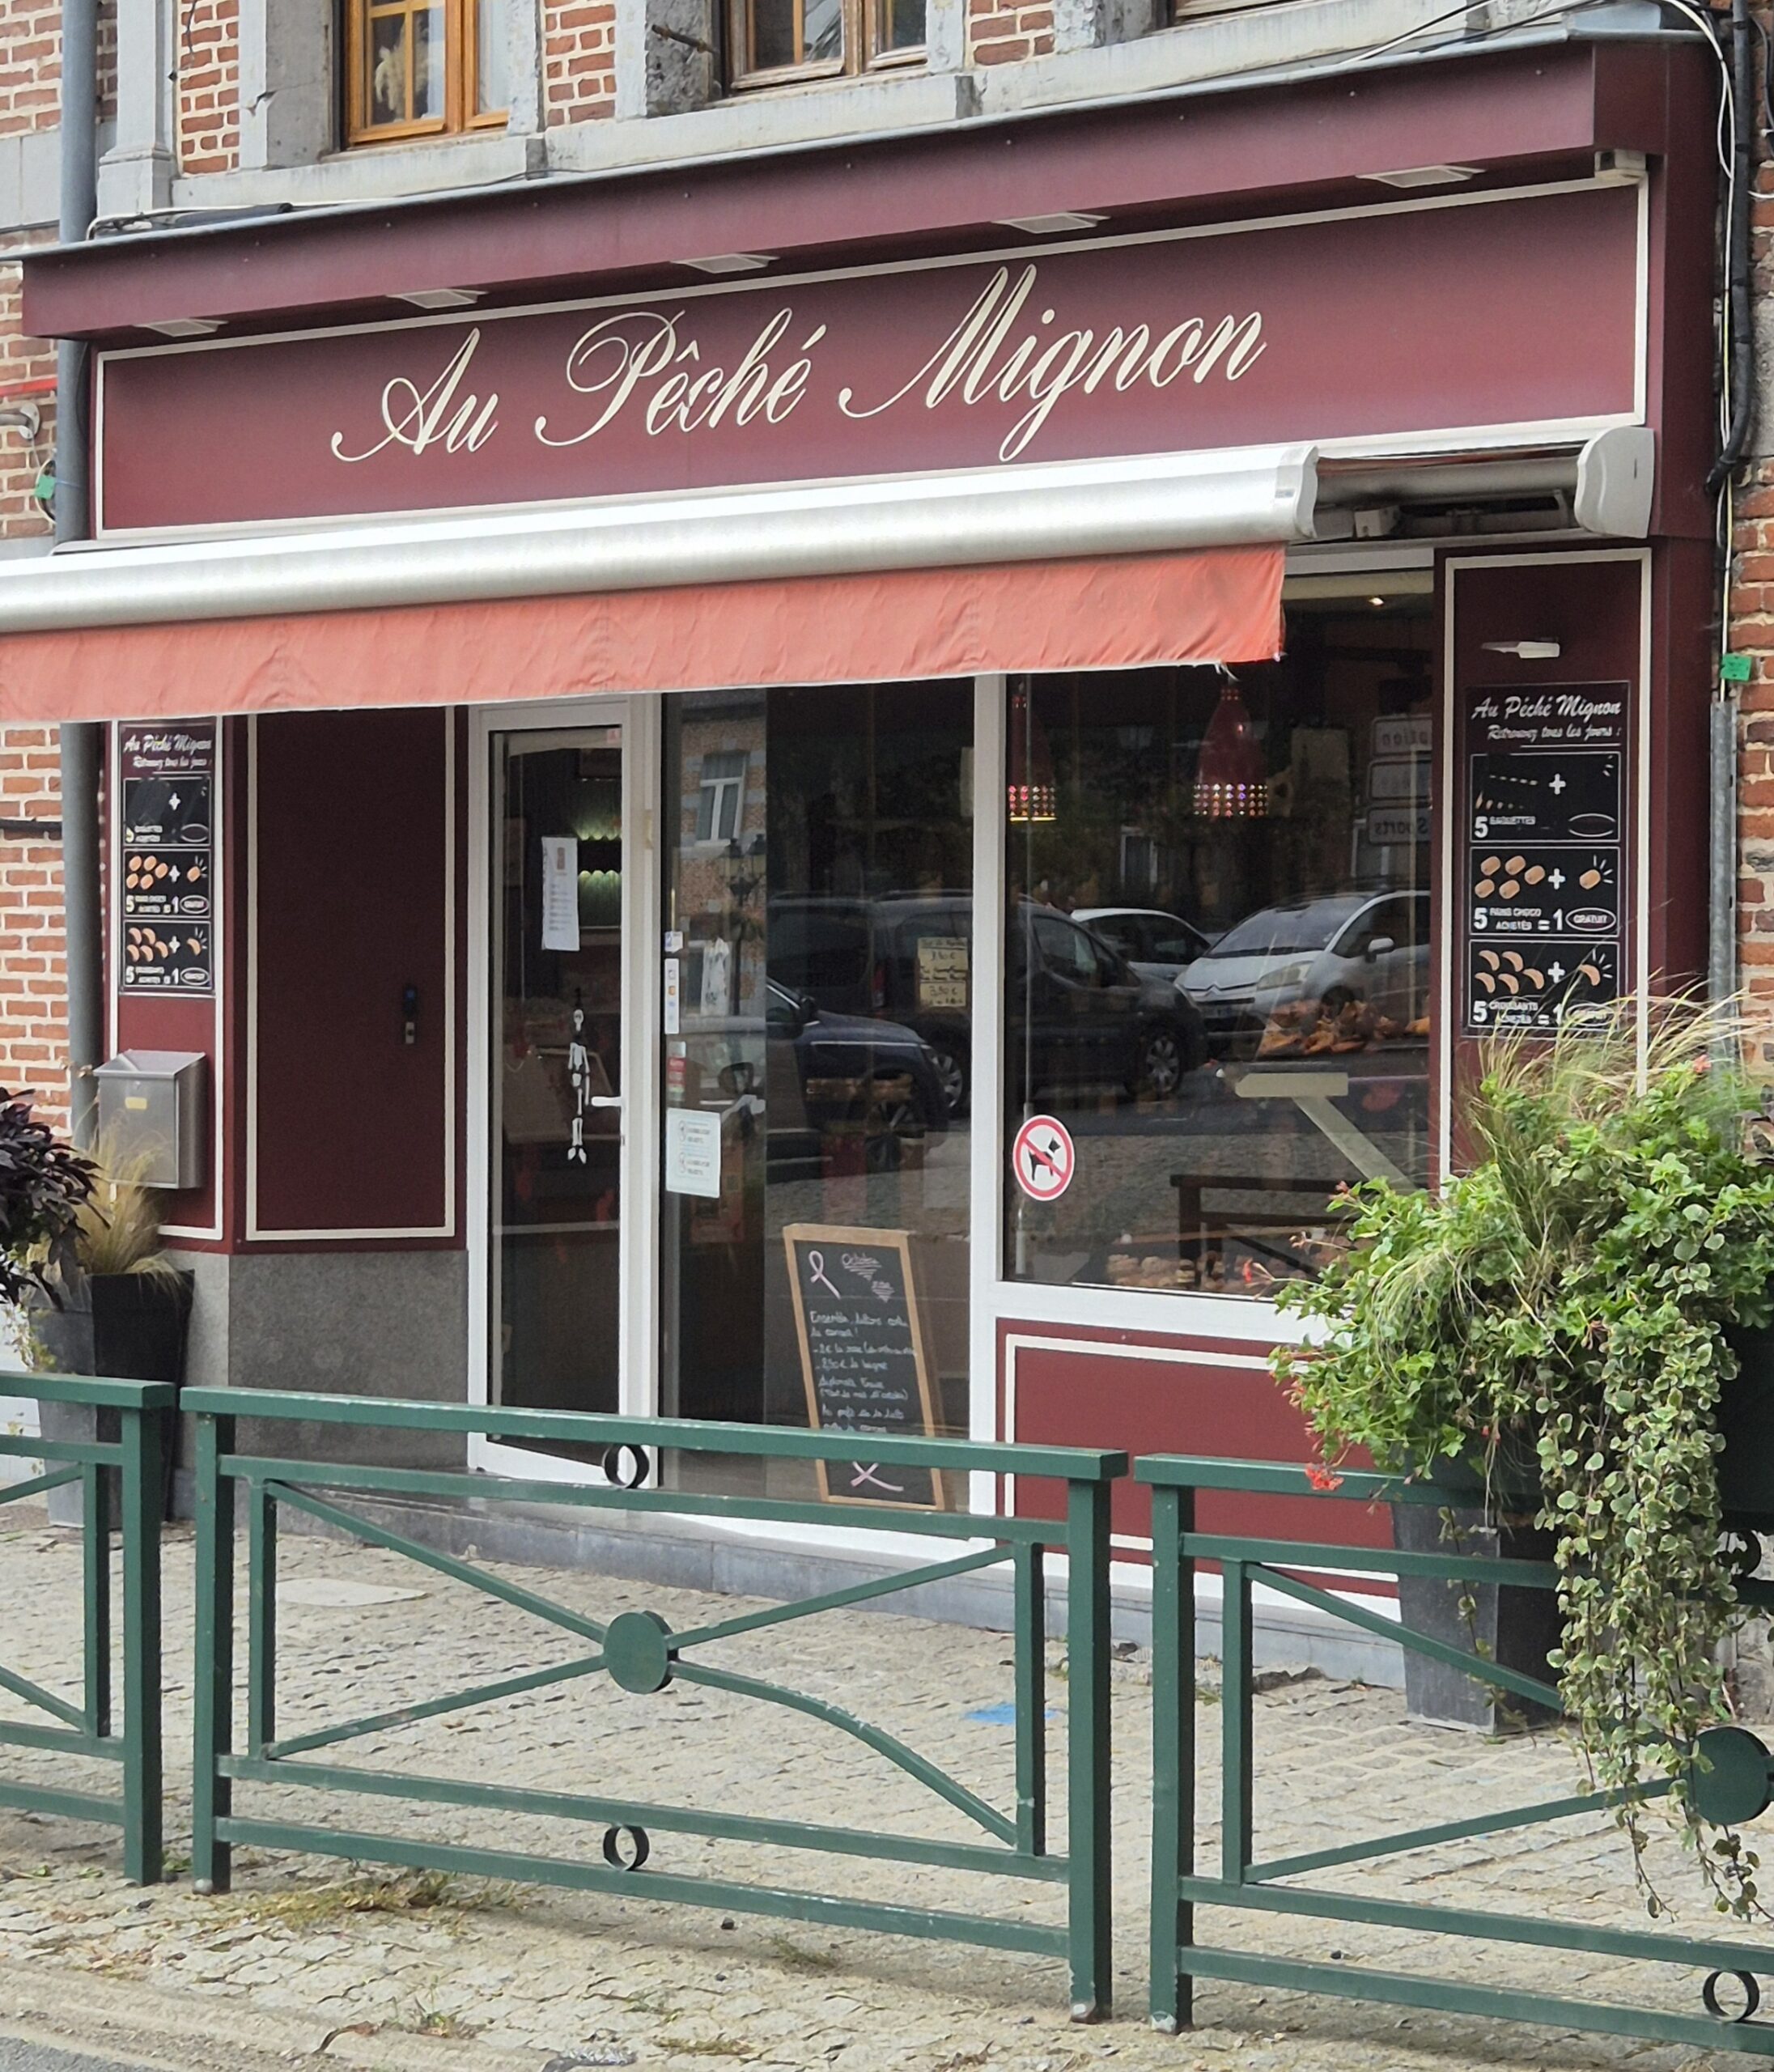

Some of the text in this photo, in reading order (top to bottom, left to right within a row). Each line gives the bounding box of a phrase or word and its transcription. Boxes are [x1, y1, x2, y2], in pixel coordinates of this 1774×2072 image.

[331, 264, 1267, 462] Au Pêché Mignon
[1471, 696, 1499, 720] Au
[1555, 694, 1622, 723] Mignon
[1475, 816, 1488, 839] 5
[1474, 907, 1488, 930] 5
[1553, 907, 1563, 931] 1
[1473, 1000, 1488, 1022] 5
